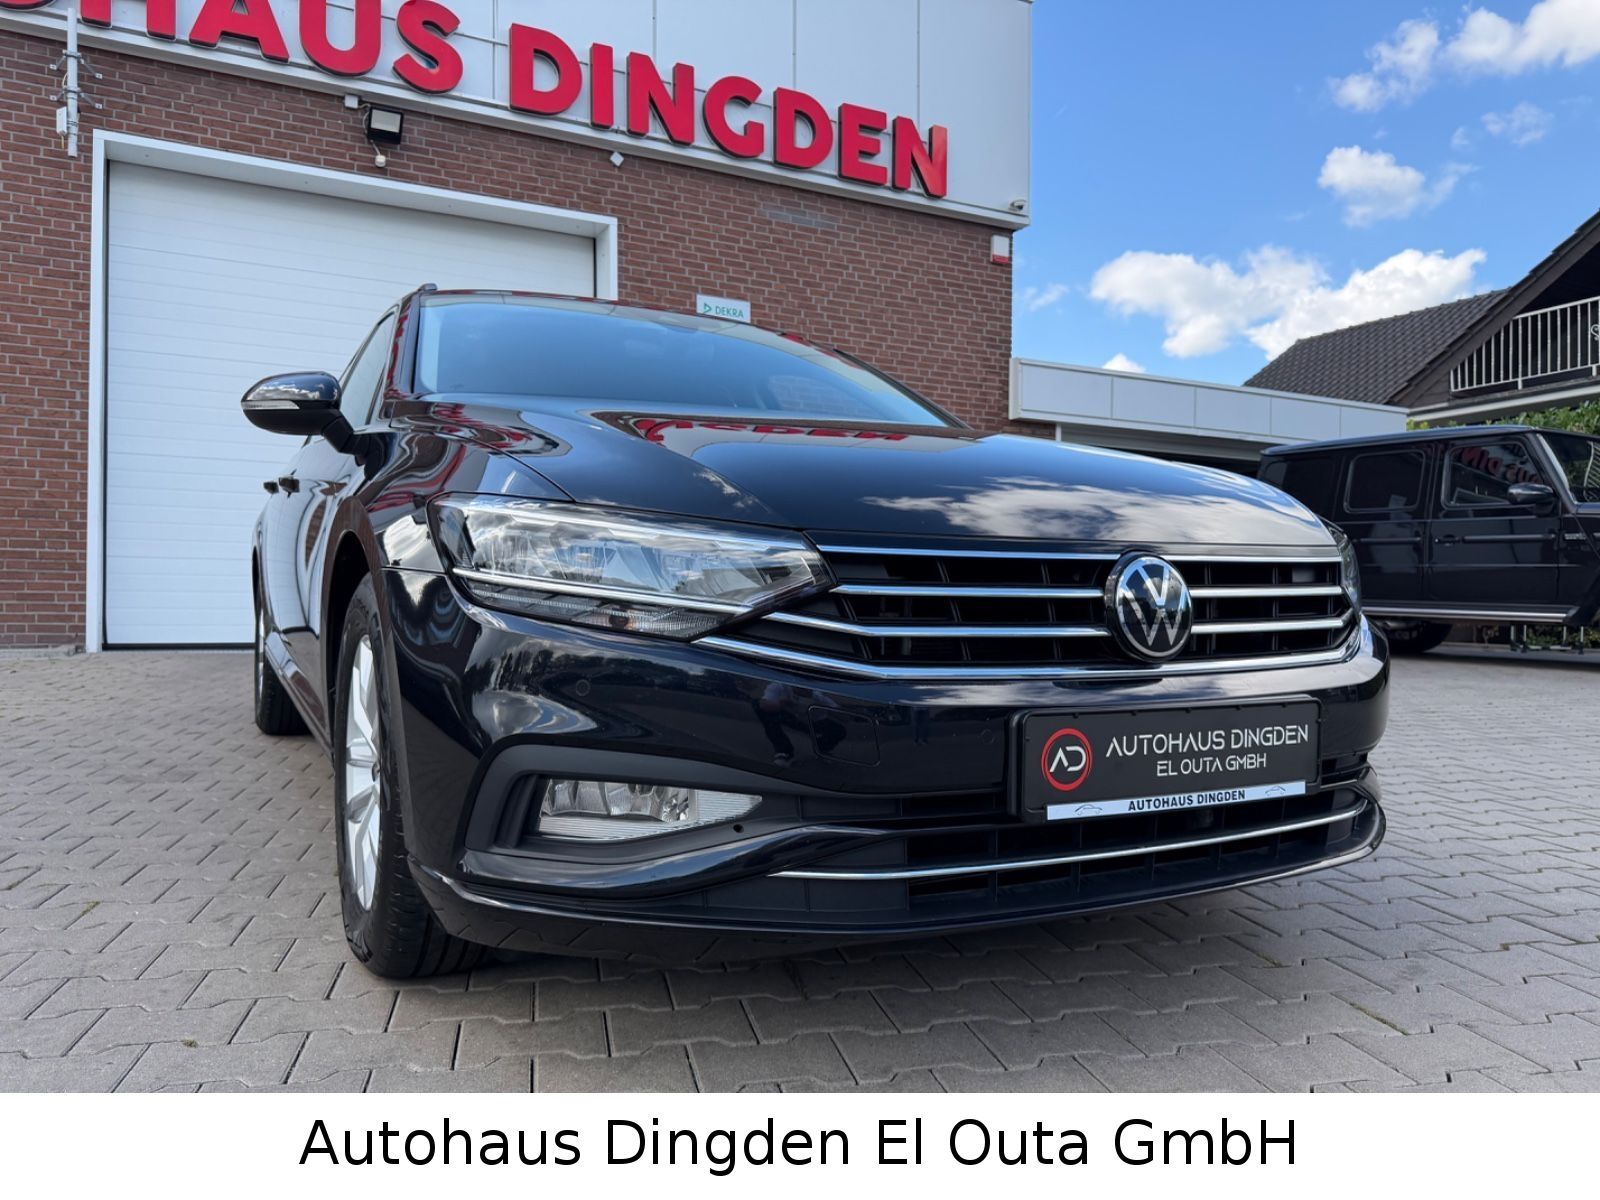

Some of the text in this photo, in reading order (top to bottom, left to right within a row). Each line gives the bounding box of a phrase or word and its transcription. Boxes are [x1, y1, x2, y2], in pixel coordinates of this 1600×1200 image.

[0, 0, 948, 199] AUS DINGDEN
[715, 305, 744, 318] DEKRA
[1105, 724, 1309, 758] AUTOHAUS DINGDEN
[1156, 753, 1267, 777] EL OUTA GMBH
[1128, 789, 1246, 812] AUTOHAUS DINGDEN
